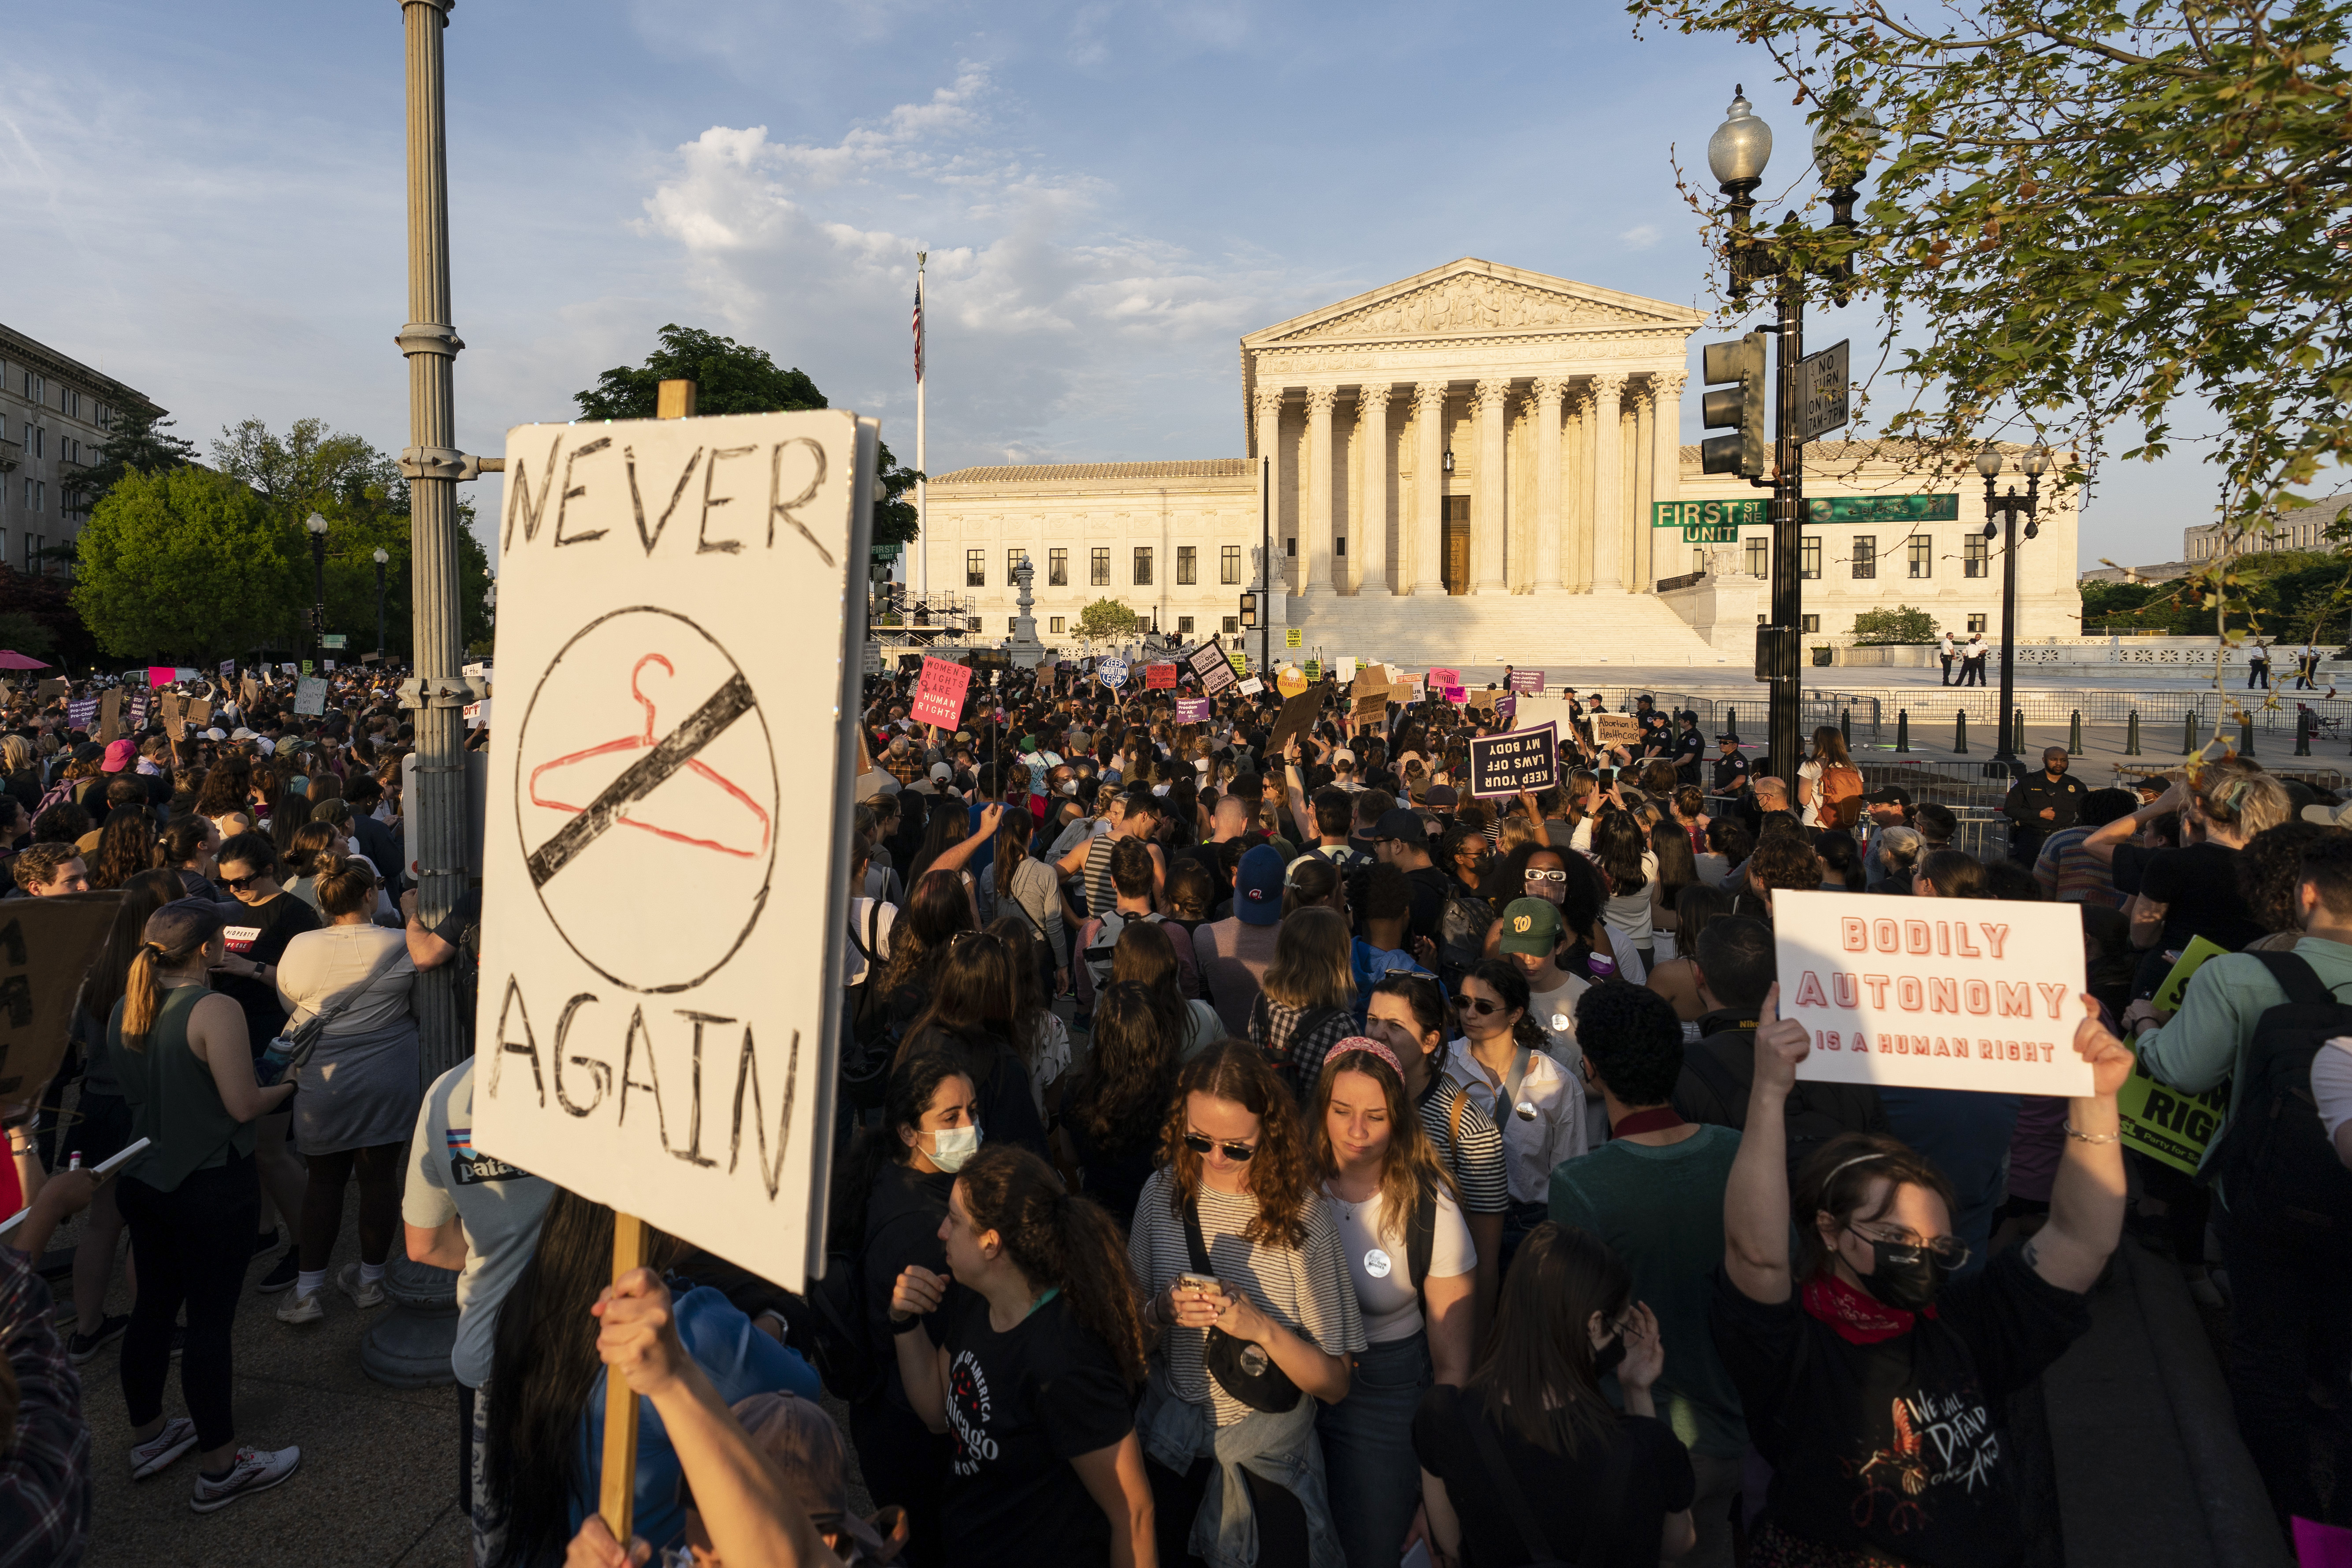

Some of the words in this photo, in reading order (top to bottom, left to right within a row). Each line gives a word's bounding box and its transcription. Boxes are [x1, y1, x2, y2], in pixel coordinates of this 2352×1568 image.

[1385, 355, 1423, 364] EQUAL
[1426, 352, 1471, 363] JUSTICE
[1478, 350, 1515, 360] UNDER
[1523, 349, 1544, 358] LAW
[1819, 354, 1833, 375] NO
[1814, 369, 1839, 394] TURN
[1809, 396, 1821, 415] ON
[504, 435, 836, 568] NEVER
[1658, 502, 1739, 524] FIRST
[1743, 502, 1761, 513] ST
[1861, 505, 1909, 515] BLOCKS
[1743, 513, 1762, 523] NE
[1687, 527, 1735, 541] UNIT
[1192, 653, 1206, 663] BANS
[1195, 659, 1205, 667] OFF
[1205, 652, 1217, 661] OUR
[1197, 658, 1217, 672] BODIES
[469, 666, 478, 675] the
[927, 660, 966, 678] WOMEN'S
[1101, 667, 1127, 676] ABORTION
[1217, 671, 1229, 680] OUR
[925, 671, 963, 688] RIGHTS
[1204, 672, 1218, 682] BANS
[1210, 677, 1230, 691] BODIES
[933, 685, 951, 695] ARE
[1278, 681, 1306, 689] ABORTION
[1393, 686, 1413, 697] RIGHT
[924, 692, 956, 708] HUMAN
[918, 702, 956, 720] RIGHTS
[1368, 712, 1383, 721] ABORTION
[1598, 717, 1628, 728] Abortion
[1631, 721, 1639, 731] is
[1600, 728, 1639, 742] Healthcare
[1490, 742, 1520, 755] BODY
[1526, 738, 1540, 751] MY
[1487, 760, 1509, 771] OFF
[1514, 754, 1544, 769] LAWS
[1485, 775, 1517, 788] YOUR
[1523, 770, 1548, 784] KEEP
[1841, 917, 2010, 959] BODILY
[1795, 971, 2068, 1019] AUTONOMY
[1816, 1030, 1841, 1051] IS
[1851, 1032, 1869, 1052] A
[1877, 1033, 1969, 1059] HUMAN
[1978, 1039, 2055, 1063] RIGHT
[489, 973, 801, 1202] AGAIN
[2141, 1088, 2216, 1146] RIG
[2118, 1120, 2137, 1137] SL
[2144, 1132, 2168, 1152] Party
[2171, 1146, 2186, 1157] for
[460, 1158, 529, 1185] pata
[964, 1351, 974, 1365] OF
[970, 1360, 991, 1423] AMERICA
[1906, 1390, 1938, 1424] WE
[946, 1382, 999, 1461] hicago
